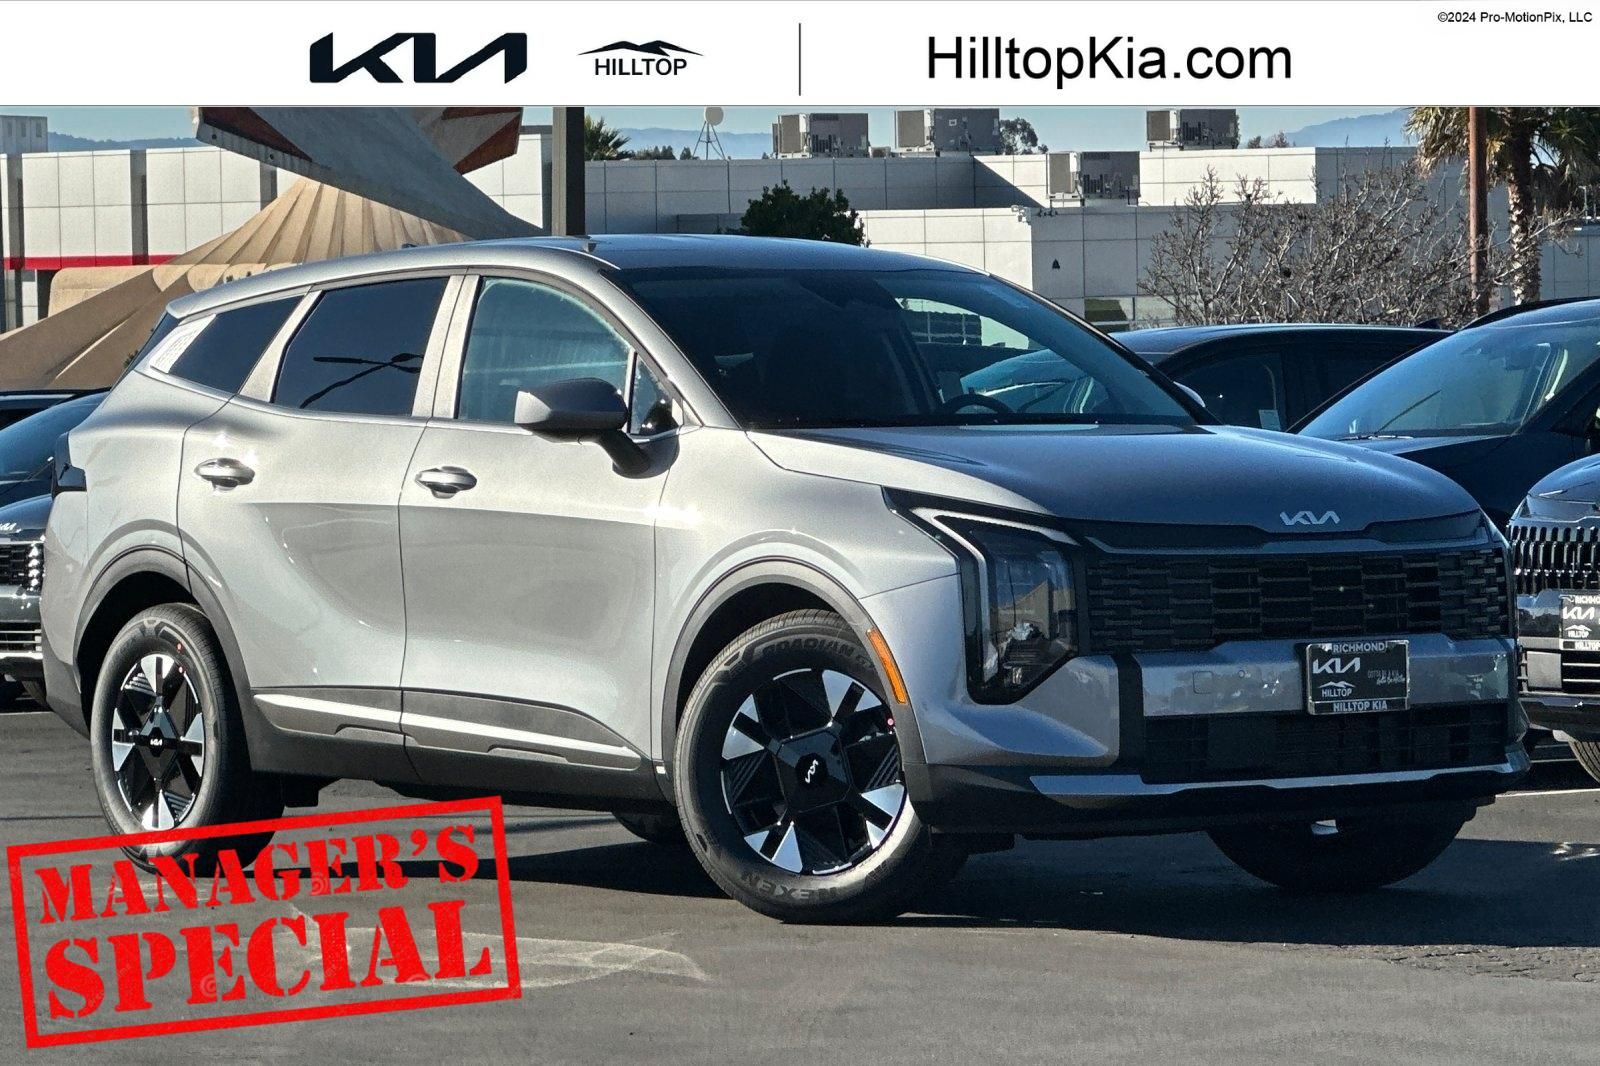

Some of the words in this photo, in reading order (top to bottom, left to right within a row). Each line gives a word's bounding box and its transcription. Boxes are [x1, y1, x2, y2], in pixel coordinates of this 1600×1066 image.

[1280, 510, 1341, 526] KIA
[1562, 606, 1596, 620] KIA
[1333, 642, 1386, 654] RICHMOND
[1312, 657, 1361, 674] KIA
[1321, 688, 1353, 698] HILLTOP
[1332, 702, 1370, 713] HILLTOP
[1371, 699, 1388, 711] KIA
